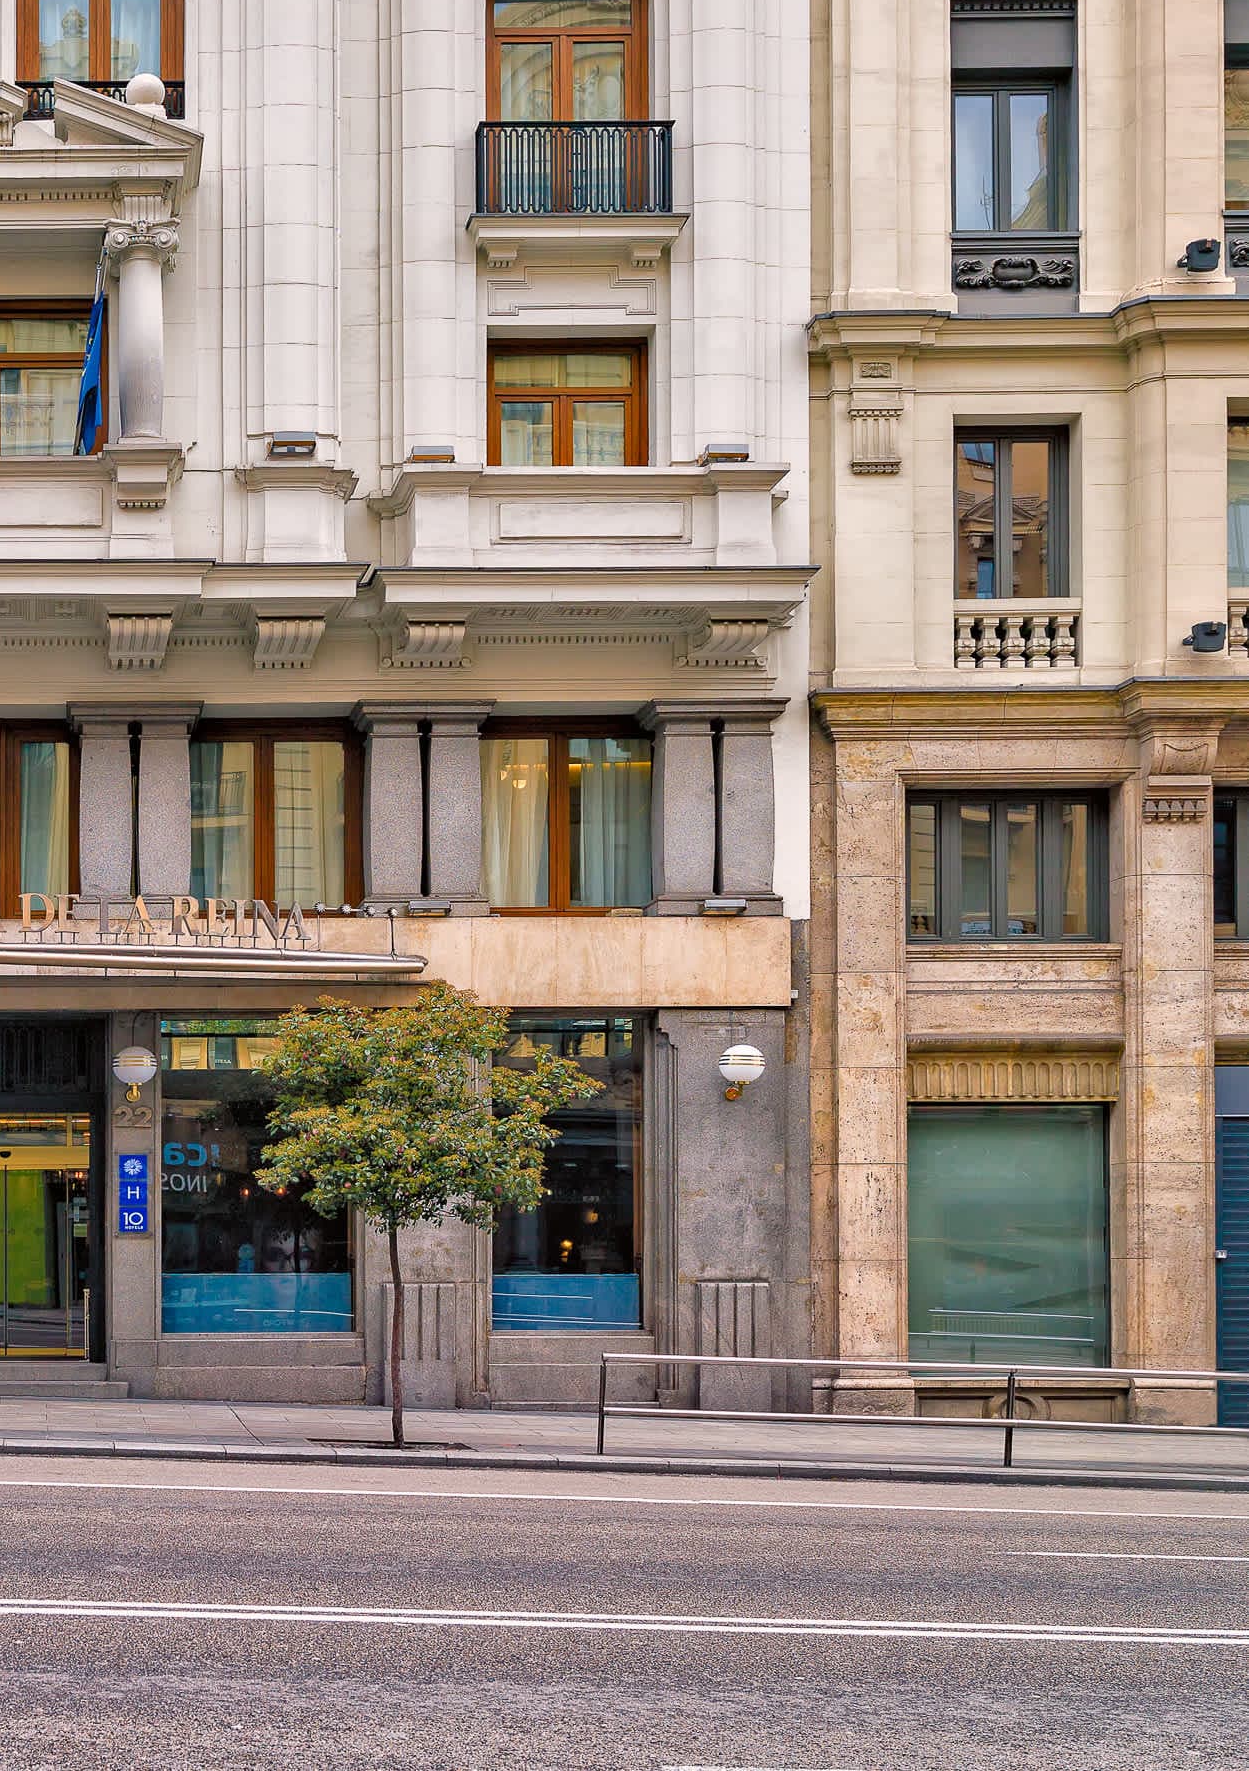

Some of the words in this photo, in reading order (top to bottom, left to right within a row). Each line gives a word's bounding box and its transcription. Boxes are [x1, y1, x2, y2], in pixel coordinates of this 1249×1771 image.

[18, 893, 80, 933] DE
[96, 894, 157, 935] LA
[168, 896, 312, 940] REINA
[112, 1106, 153, 1128] 22
[127, 1186, 139, 1199] H
[122, 1211, 144, 1225] 10
